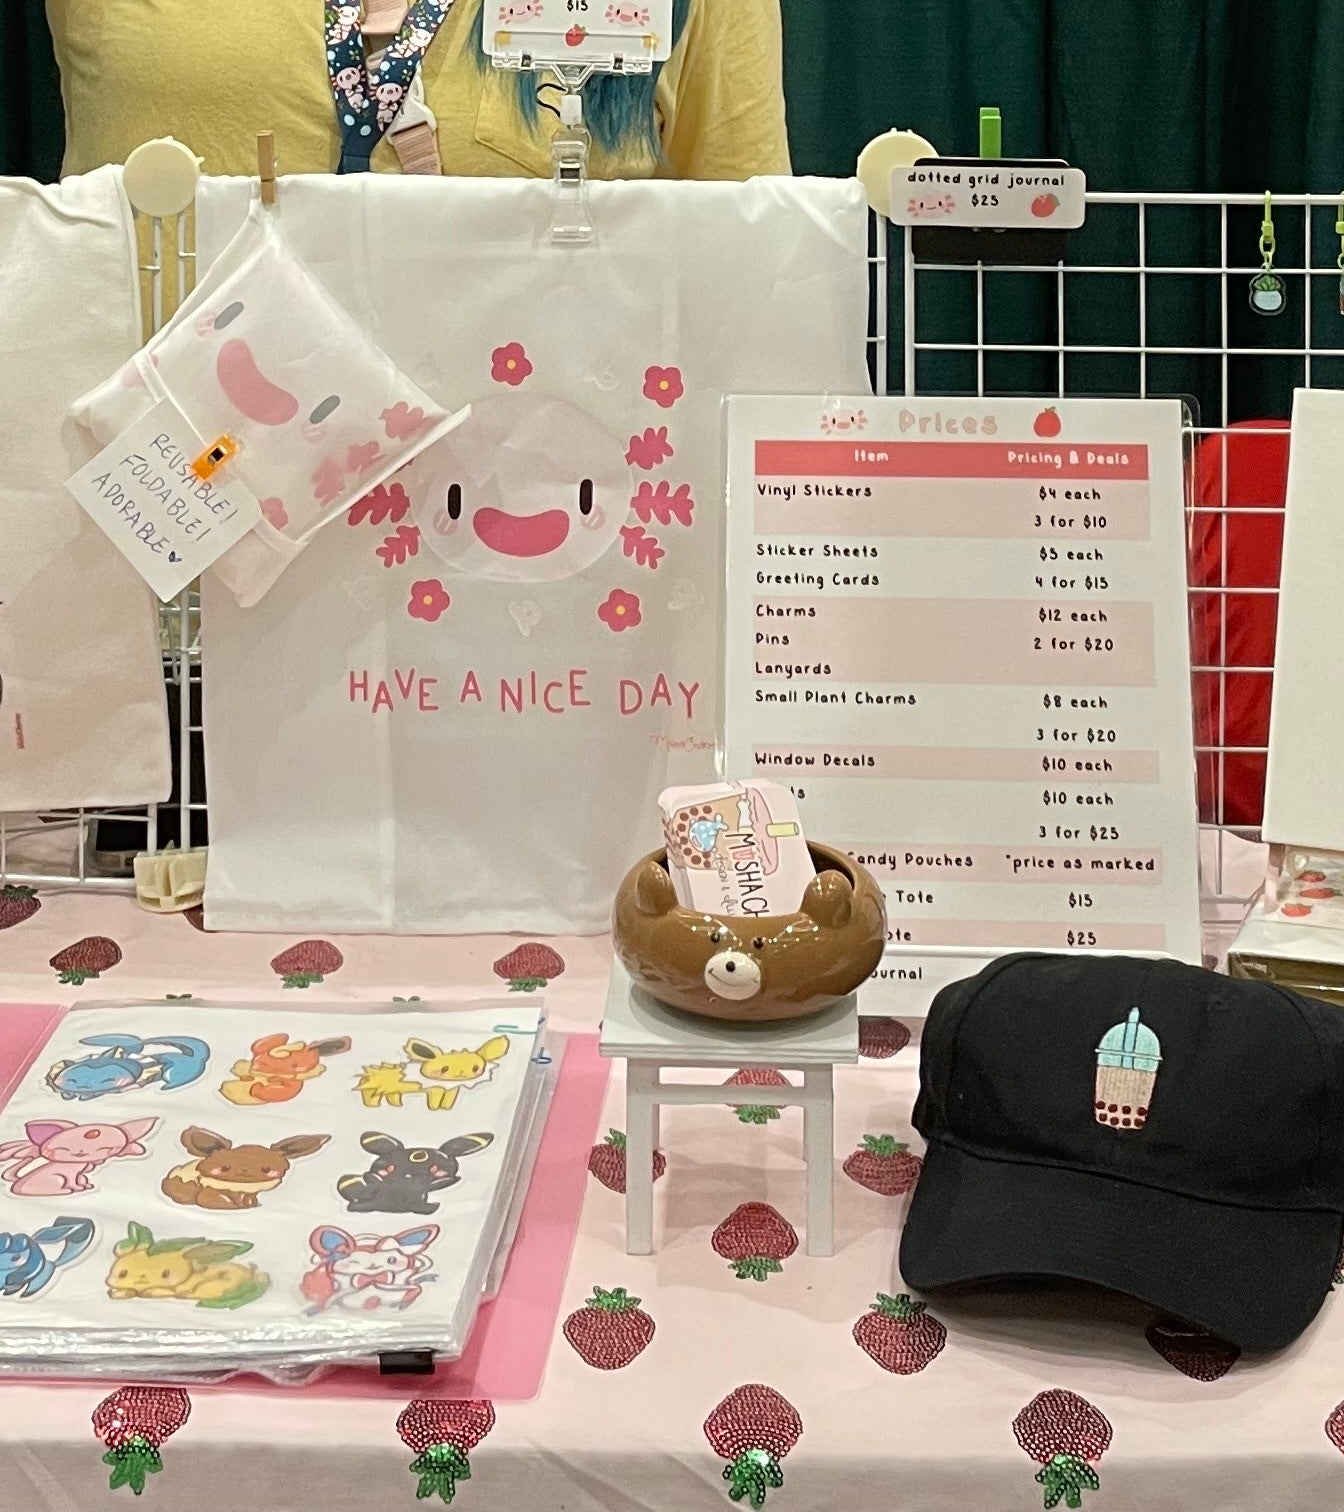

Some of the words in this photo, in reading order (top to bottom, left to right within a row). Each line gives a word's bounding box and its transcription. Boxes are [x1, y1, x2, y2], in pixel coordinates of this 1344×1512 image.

[566, 0, 589, 12] $15
[908, 172, 961, 184] dotted
[968, 173, 999, 188] grid
[1008, 174, 1065, 189] journal
[971, 193, 999, 208] $25
[899, 409, 999, 436] Prices
[854, 449, 889, 462] Item
[1008, 450, 1062, 469] Pricing
[1069, 451, 1080, 465] &
[1086, 451, 1130, 466] Deals
[149, 432, 239, 525] REUSABLE!
[118, 453, 212, 544] FOLDABLE!
[757, 483, 796, 501] Vinyl
[804, 484, 872, 498] Stickers
[1039, 486, 1057, 501] $4
[1065, 488, 1101, 500] each
[91, 472, 171, 554] ADORABLE
[1034, 515, 1042, 528] 3
[1050, 515, 1074, 529] for
[1083, 515, 1108, 530] $10
[756, 543, 814, 558] Sticker
[823, 544, 878, 558] Sheets
[1039, 547, 1058, 561] $5
[1067, 549, 1103, 561] each
[756, 571, 824, 590] Greeting
[832, 572, 880, 587] Cards
[1035, 576, 1043, 589] 4
[1052, 576, 1076, 589] for
[1084, 575, 1108, 590] $15
[756, 604, 816, 618] Charms
[1038, 607, 1062, 624] $12
[1071, 609, 1108, 623] each
[756, 633, 790, 646] Pins
[1034, 637, 1042, 650] 2
[1052, 637, 1076, 651] for
[1084, 637, 1114, 652] $20
[755, 661, 832, 680] Lanyards
[349, 667, 439, 714] HAVE
[459, 669, 483, 704] A
[500, 668, 592, 714] NICE
[619, 672, 700, 719] DAY
[755, 690, 798, 704] Small
[805, 690, 847, 705] Plant
[855, 692, 916, 706] Charms
[1043, 694, 1062, 710] $8
[1071, 695, 1108, 709] each
[1036, 728, 1045, 742] 3
[1053, 727, 1078, 743] for
[1087, 727, 1116, 744] $20
[755, 752, 815, 767] Window
[823, 754, 876, 768] Decals
[1042, 757, 1067, 774] $10
[1075, 759, 1113, 773] each
[1043, 790, 1068, 807] $10
[1076, 792, 1114, 806] each
[1039, 825, 1047, 840] 3
[1056, 825, 1081, 840] for
[1090, 825, 1120, 841] $25
[905, 852, 974, 867] Pouches
[1063, 858, 1083, 870] as
[1091, 856, 1156, 872] marked
[896, 890, 934, 904] Tote
[1068, 891, 1093, 909] $15
[1067, 930, 1097, 947] $25
